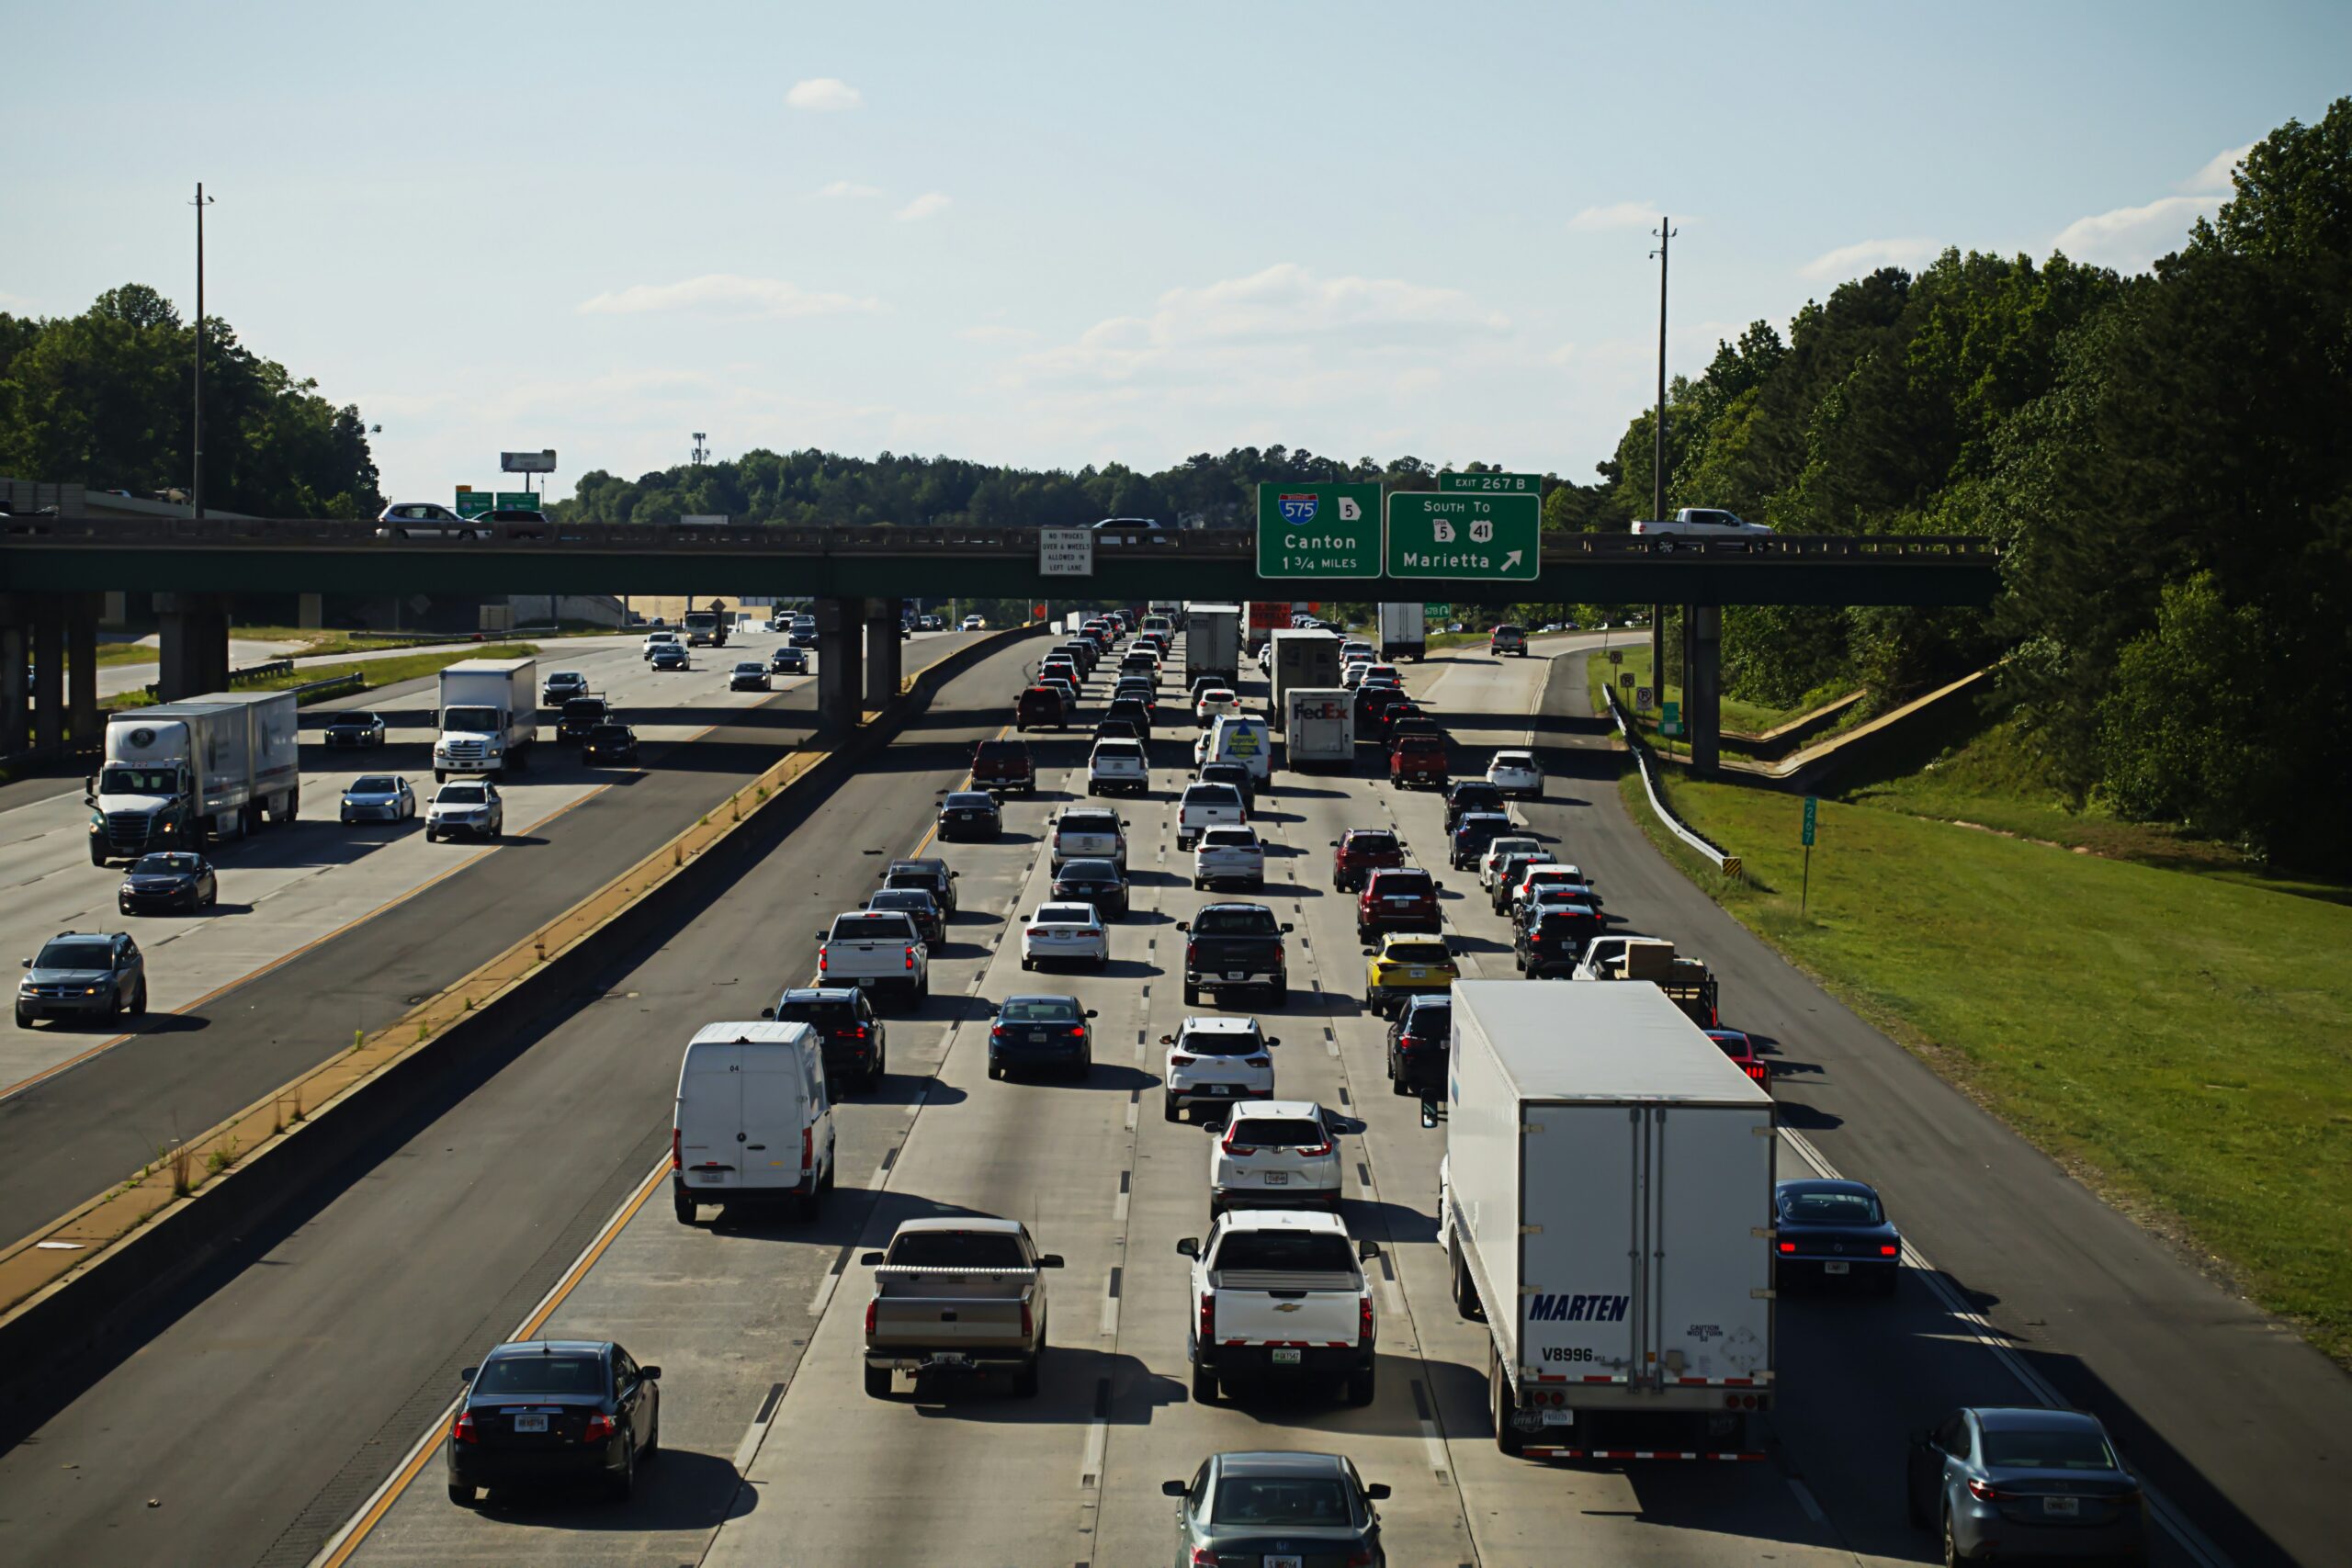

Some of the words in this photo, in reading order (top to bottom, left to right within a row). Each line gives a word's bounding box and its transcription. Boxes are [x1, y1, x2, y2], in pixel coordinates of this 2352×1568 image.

[1455, 479, 1476, 487] EXIT
[1482, 478, 1511, 489] 267
[1517, 479, 1525, 490] B
[1285, 502, 1314, 517] 575
[1345, 504, 1353, 517] 5
[1440, 526, 1448, 539] 5
[1473, 525, 1488, 538] 41
[1284, 534, 1356, 548] Canton
[1283, 557, 1288, 570] 1
[1321, 558, 1357, 568] MILES
[1403, 552, 1489, 568] Marietta
[1294, 703, 1349, 720] FedEx
[1528, 1294, 1630, 1322] MARTEN
[1542, 1348, 1593, 1362] V8996
